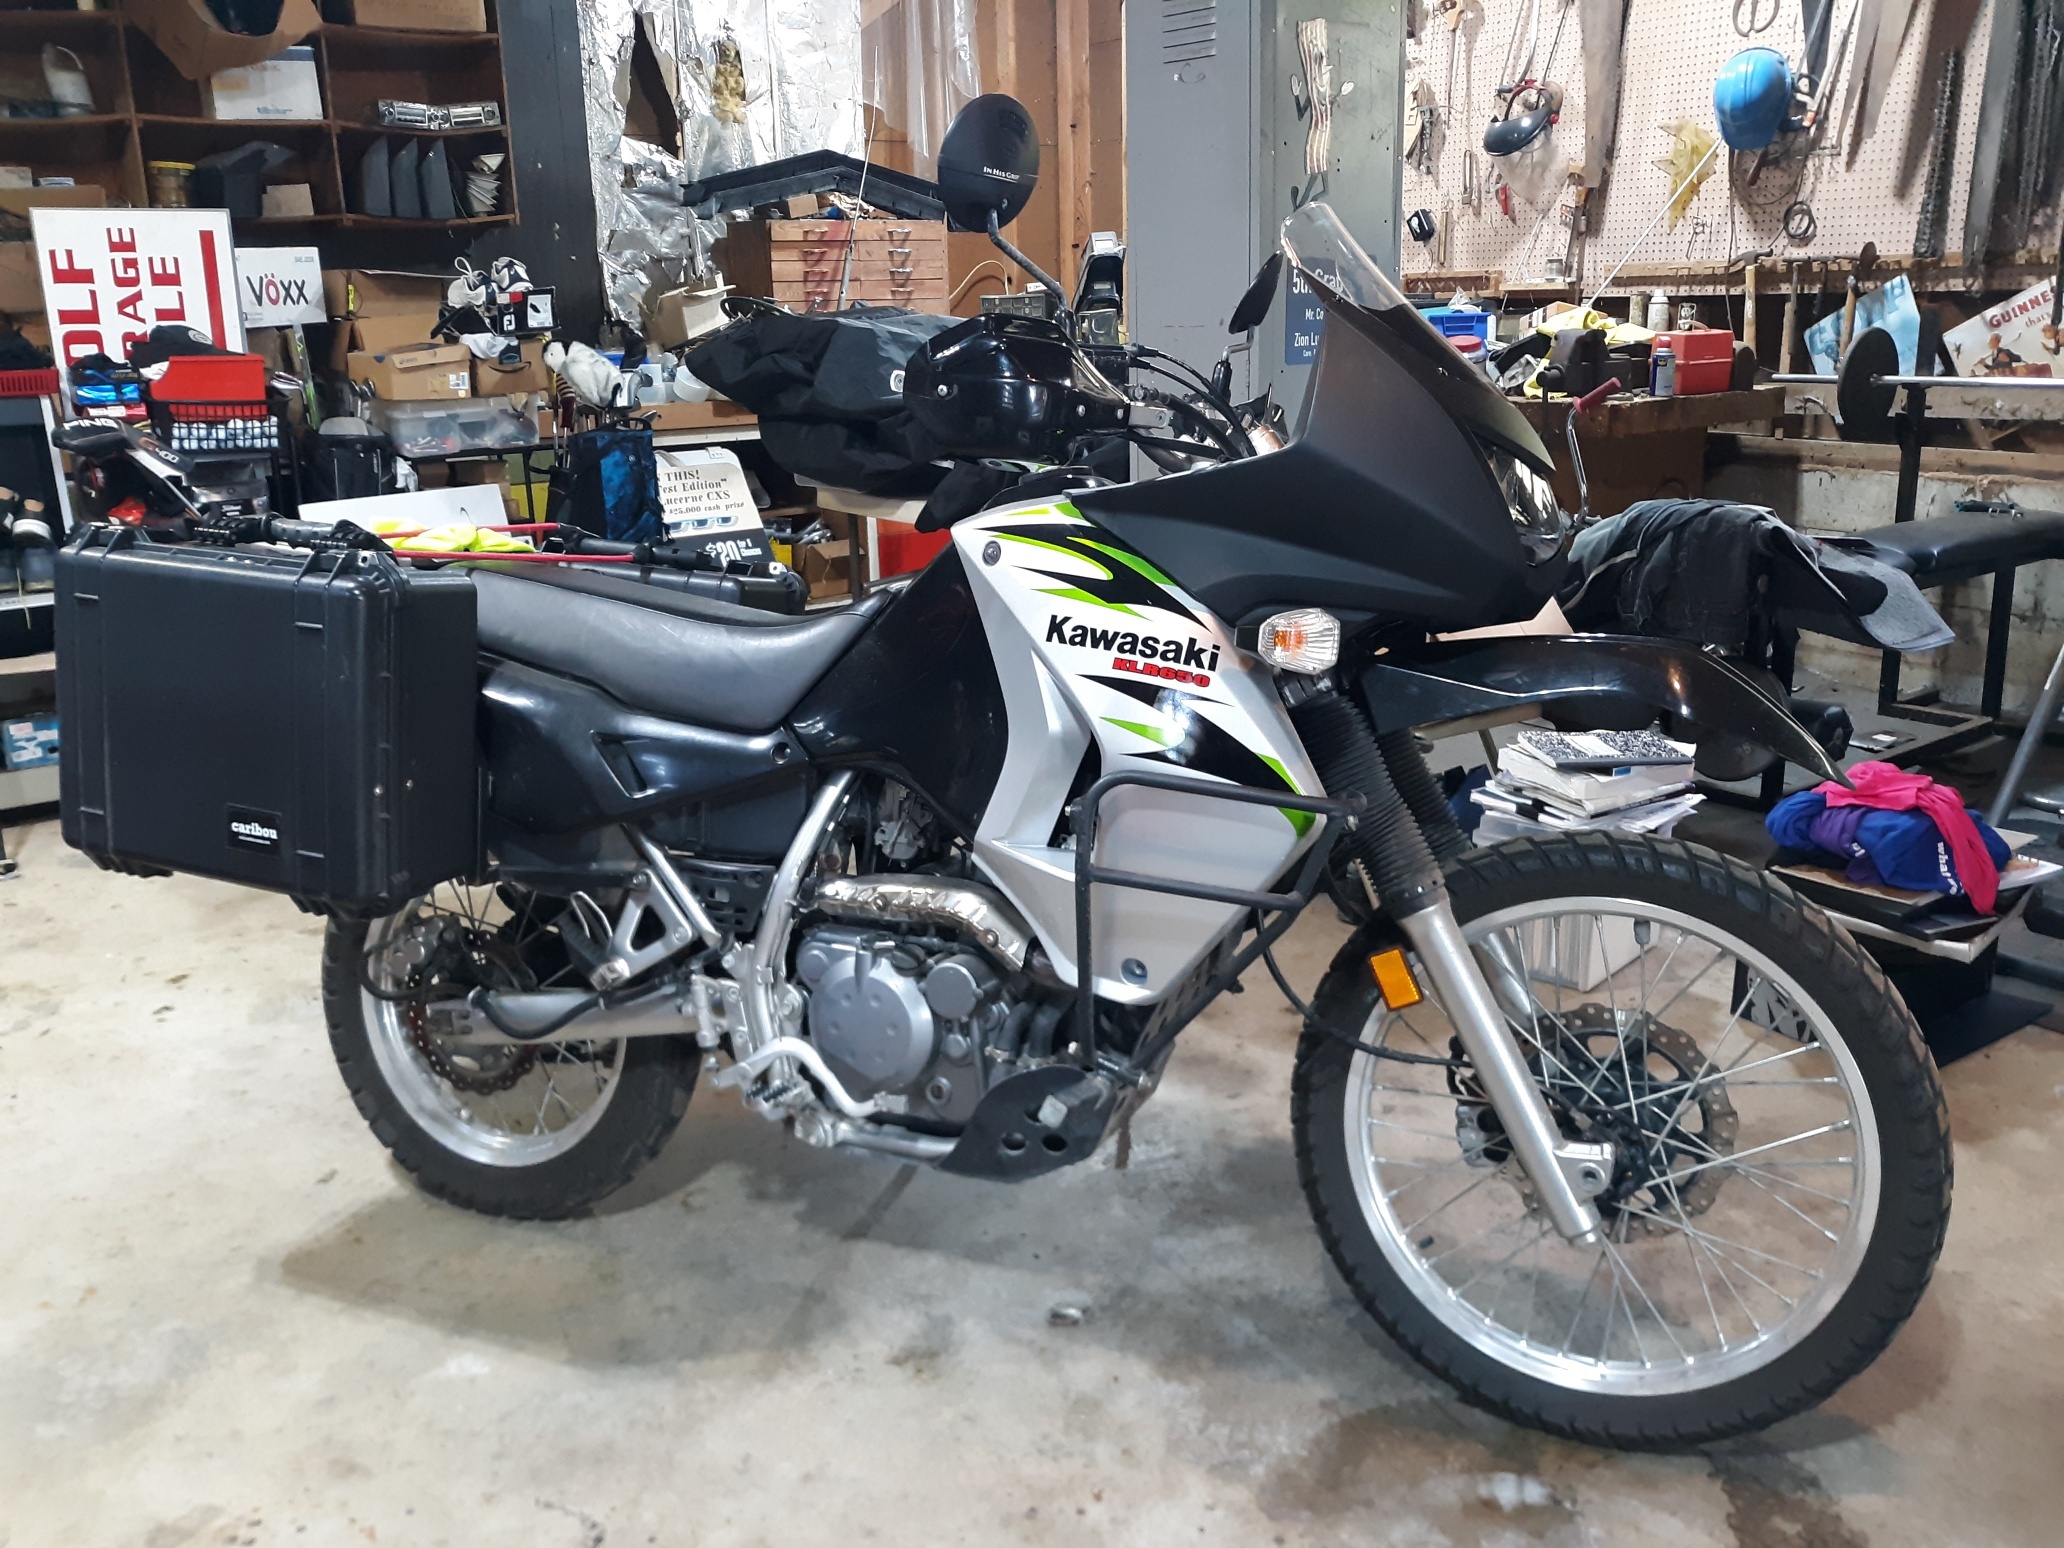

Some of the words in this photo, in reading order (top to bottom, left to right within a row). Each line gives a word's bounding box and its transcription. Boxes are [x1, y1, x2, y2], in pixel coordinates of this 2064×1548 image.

[106, 227, 150, 361] RAGE
[148, 257, 186, 322] LE
[48, 249, 105, 367] OLF
[1316, 308, 1324, 320] Co
[1294, 332, 1309, 347] Zion
[664, 469, 700, 482] THIS!
[706, 490, 731, 501] CXS
[704, 504, 721, 512] cash
[705, 540, 742, 567] $20
[1045, 614, 1221, 672] Kawasaki
[1112, 657, 1211, 687] KLR650
[231, 821, 278, 840] caribou
